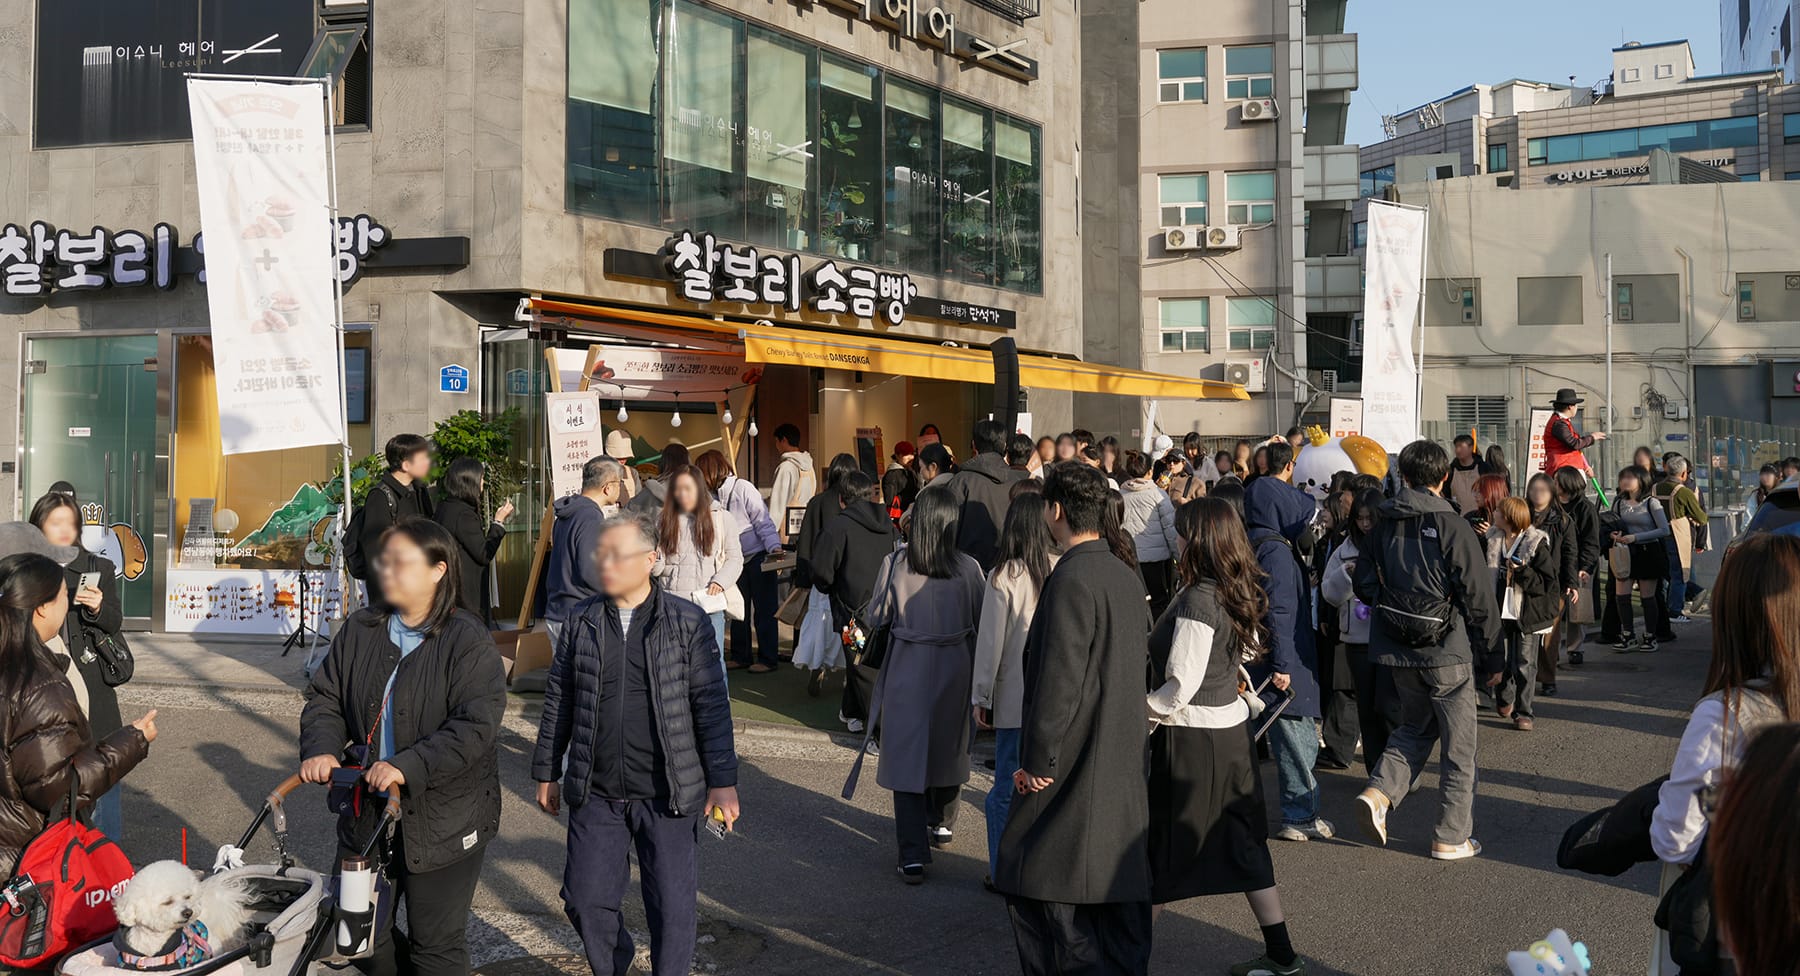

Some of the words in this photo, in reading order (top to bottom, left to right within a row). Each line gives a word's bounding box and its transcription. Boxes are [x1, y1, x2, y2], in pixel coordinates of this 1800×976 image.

[116, 44, 162, 61] 이수니
[178, 40, 214, 56] 헤어
[1557, 168, 1608, 182] 하이모
[0, 221, 171, 295] 찰보리
[673, 231, 801, 311] 찰보리
[814, 261, 918, 326] 소금빵
[968, 306, 1000, 324] 단석가
[766, 346, 786, 358] Chewy
[829, 352, 871, 365] DANSEOKGA
[448, 378, 461, 390] 10
[566, 415, 585, 427] 이벤트
